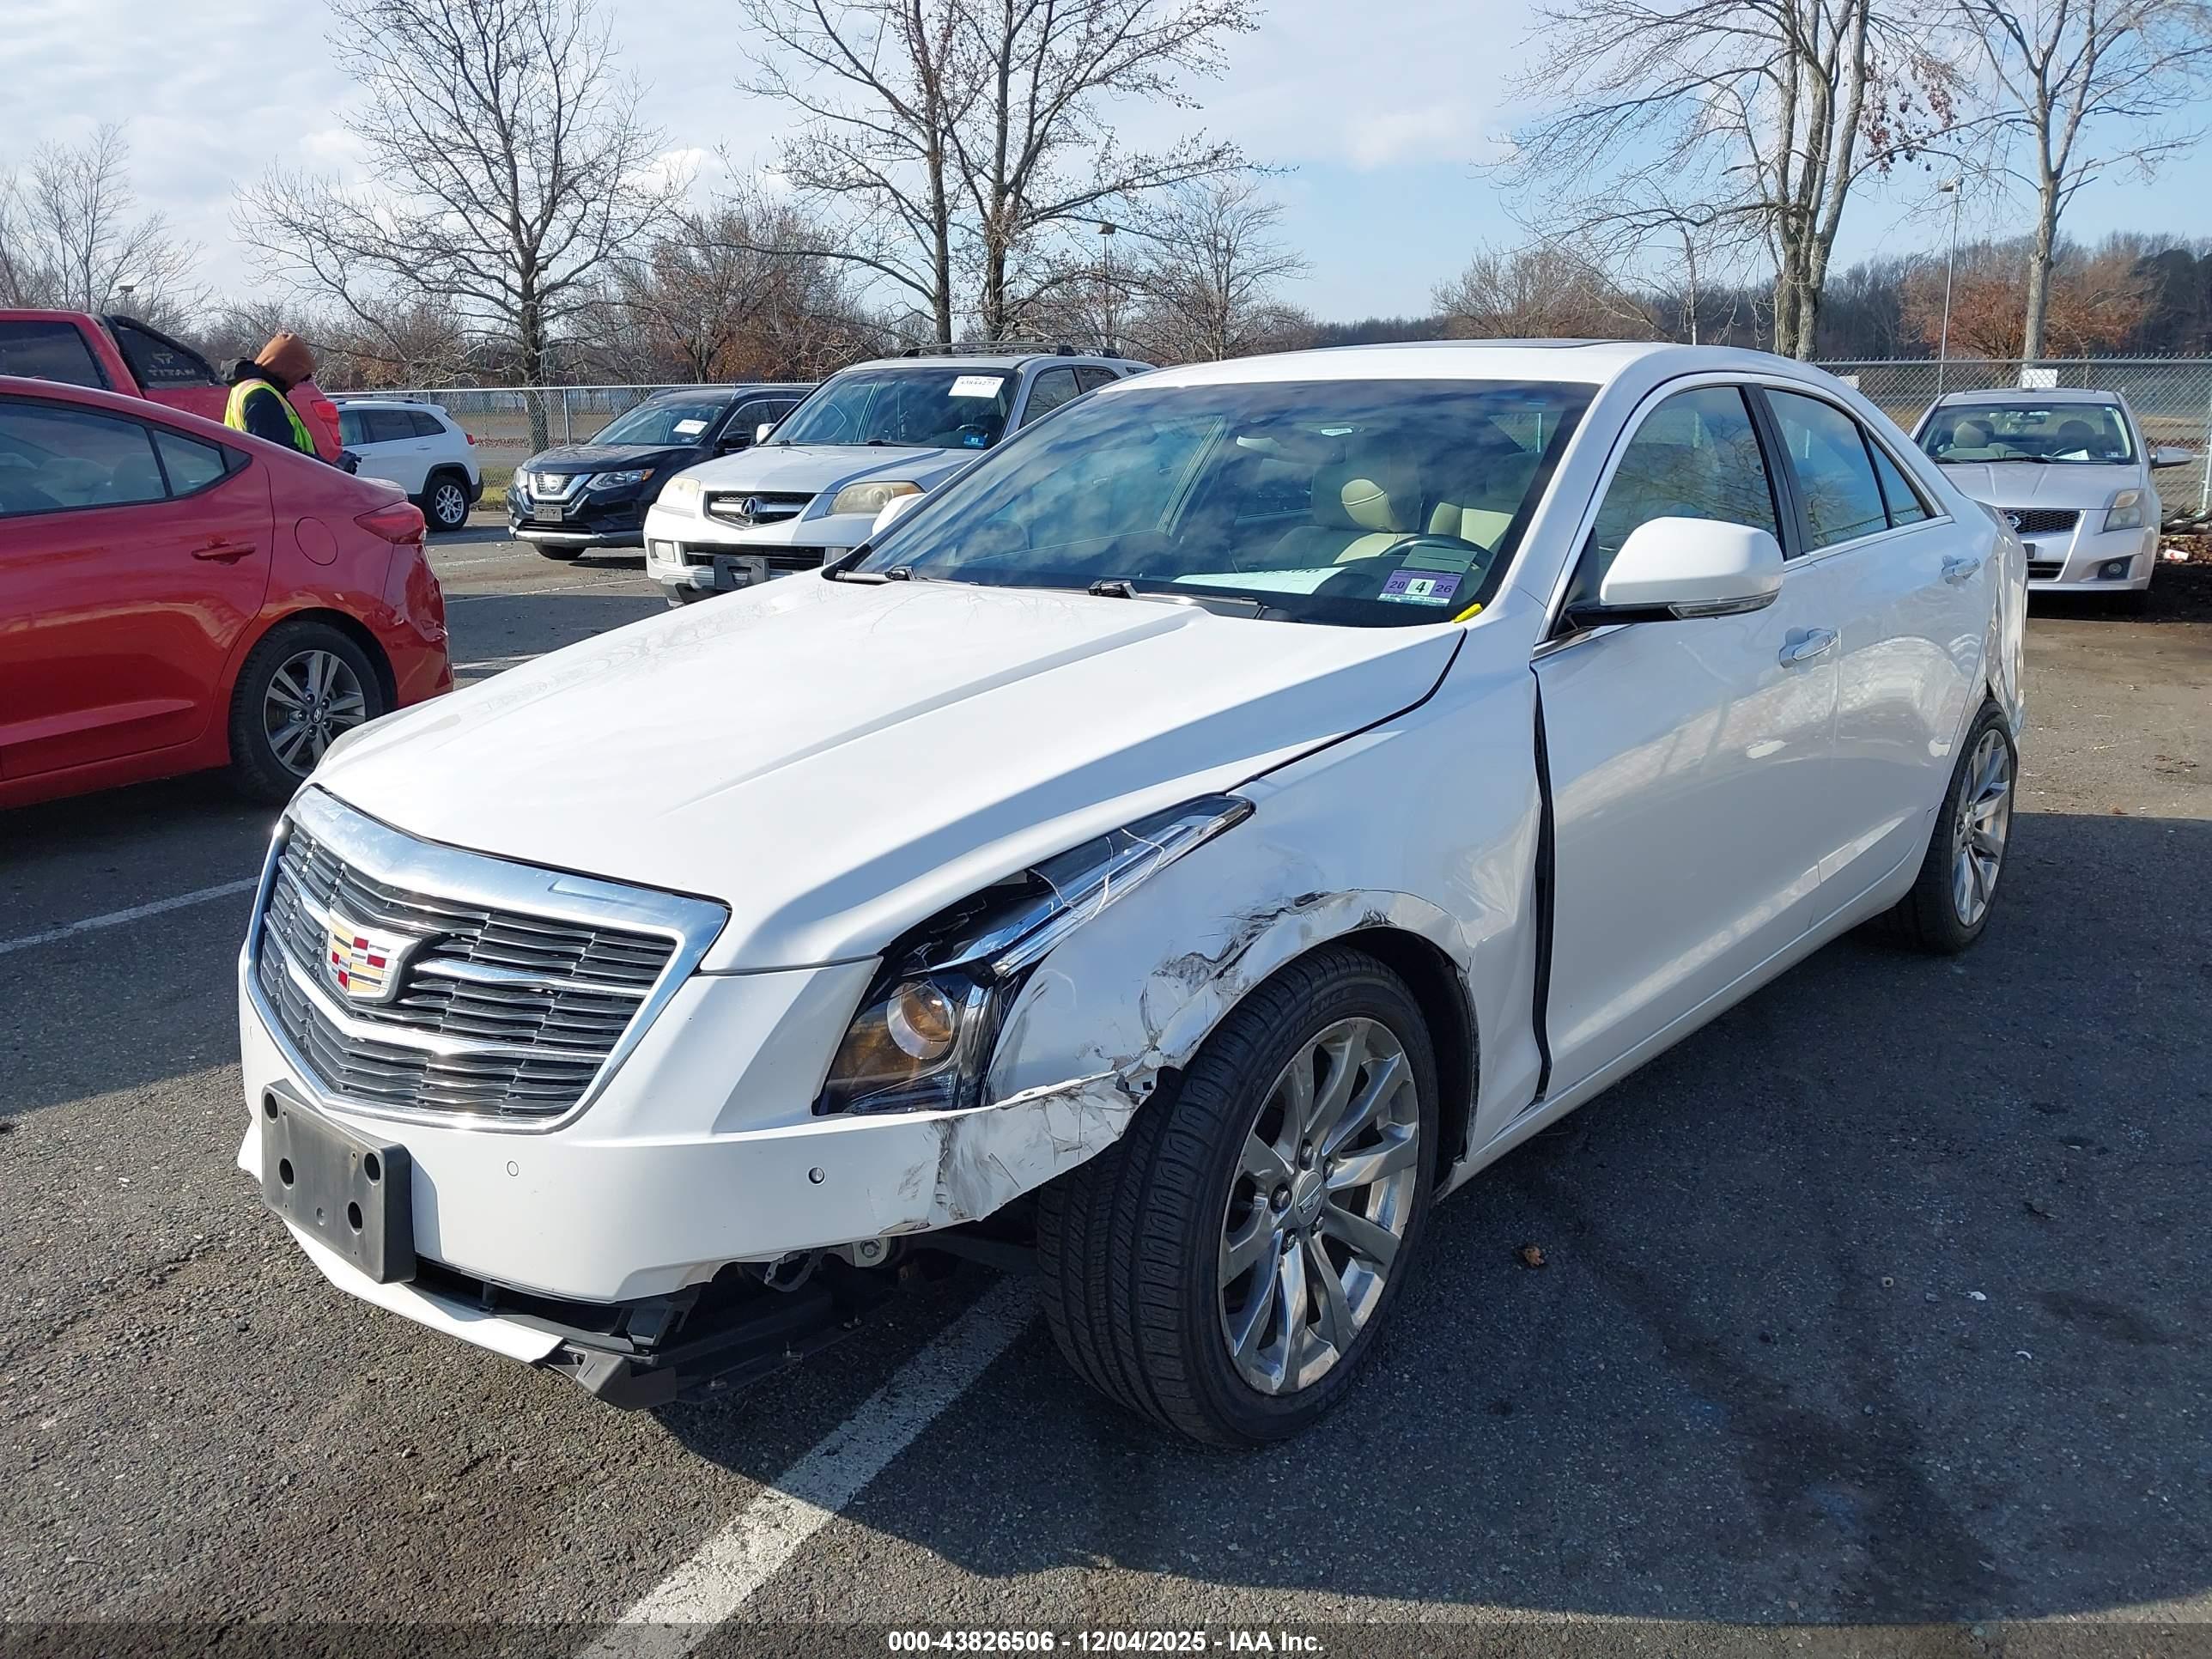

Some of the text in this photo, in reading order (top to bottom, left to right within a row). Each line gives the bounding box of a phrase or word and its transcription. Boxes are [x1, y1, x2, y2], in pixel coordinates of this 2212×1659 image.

[147, 367, 196, 376] TITAN
[1389, 580, 1405, 589] 20
[1414, 580, 1426, 593] 4
